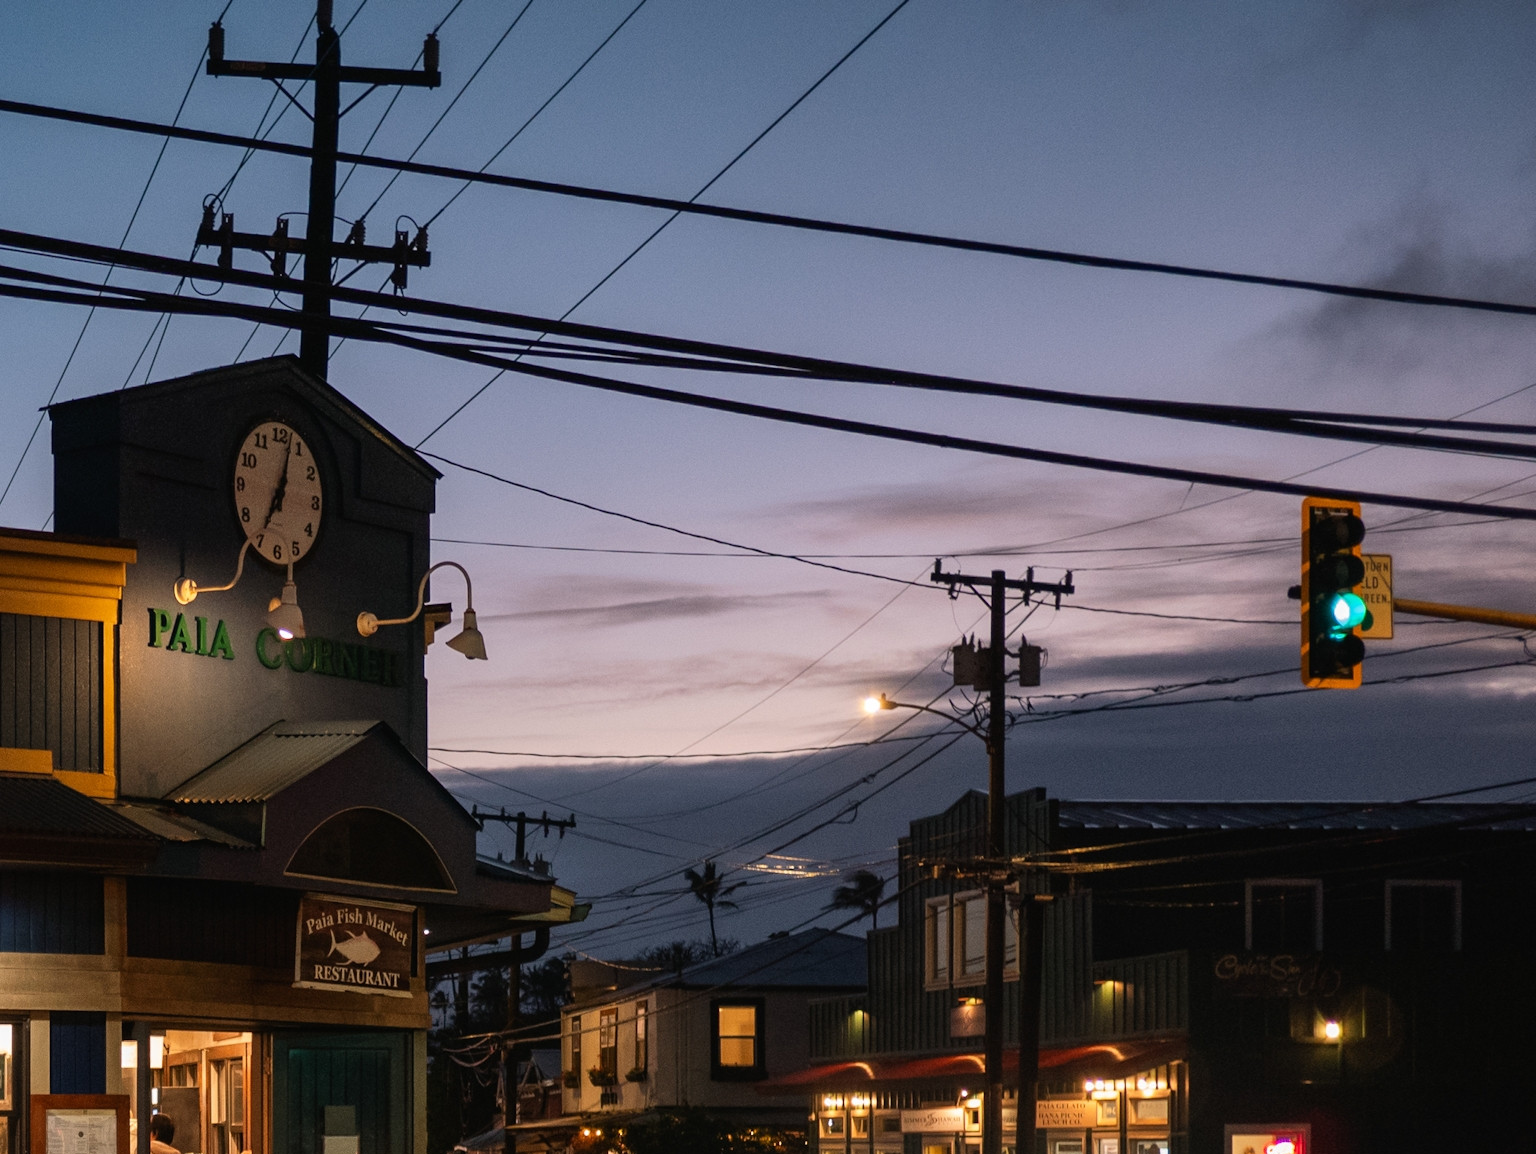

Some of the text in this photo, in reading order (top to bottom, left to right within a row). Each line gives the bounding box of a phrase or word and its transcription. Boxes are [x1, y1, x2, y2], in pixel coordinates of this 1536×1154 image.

[254, 433, 268, 450] 11
[271, 427, 288, 443] 12
[295, 442, 302, 456] 1
[241, 452, 257, 468] 10
[306, 466, 315, 481] 2
[236, 477, 245, 492] 9
[311, 496, 320, 511] 3
[241, 507, 250, 523] 8
[304, 523, 313, 537] 4
[256, 534, 265, 548] 7
[292, 541, 300, 557] 5
[273, 544, 282, 560] 6
[147, 608, 235, 660] PAIA
[305, 908, 409, 947] Paia Fish Market
[315, 964, 401, 988] RESTAURANT
